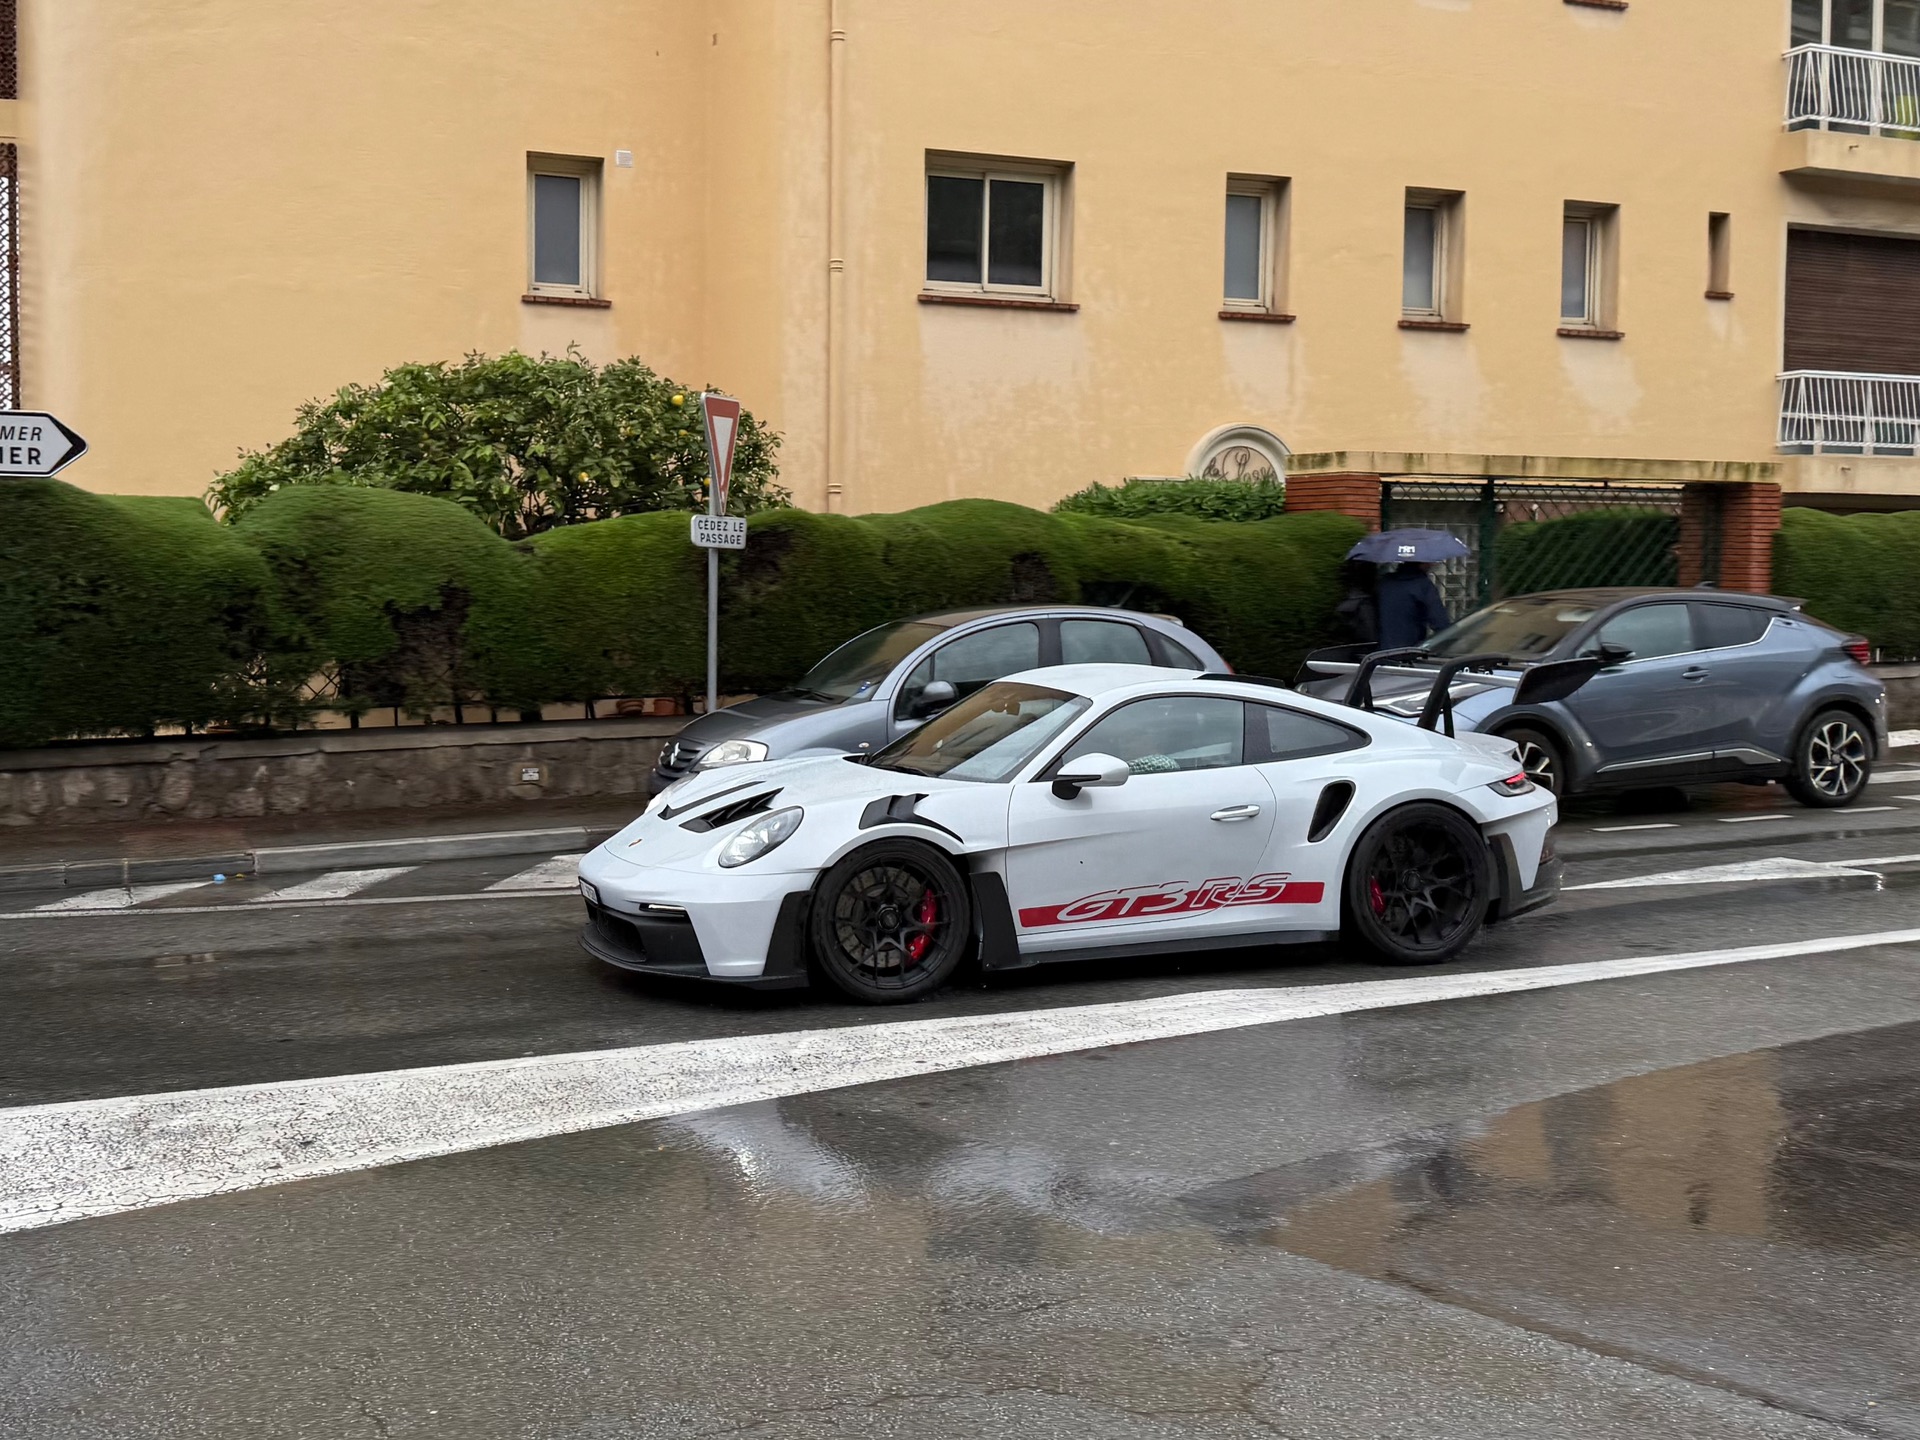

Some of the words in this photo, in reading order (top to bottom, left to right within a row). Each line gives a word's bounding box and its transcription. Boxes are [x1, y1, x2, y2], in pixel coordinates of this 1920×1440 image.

[0, 425, 42, 441] MER
[698, 518, 728, 531] CÉDEZ
[733, 522, 744, 532] LE
[700, 533, 742, 544] PASSAGE
